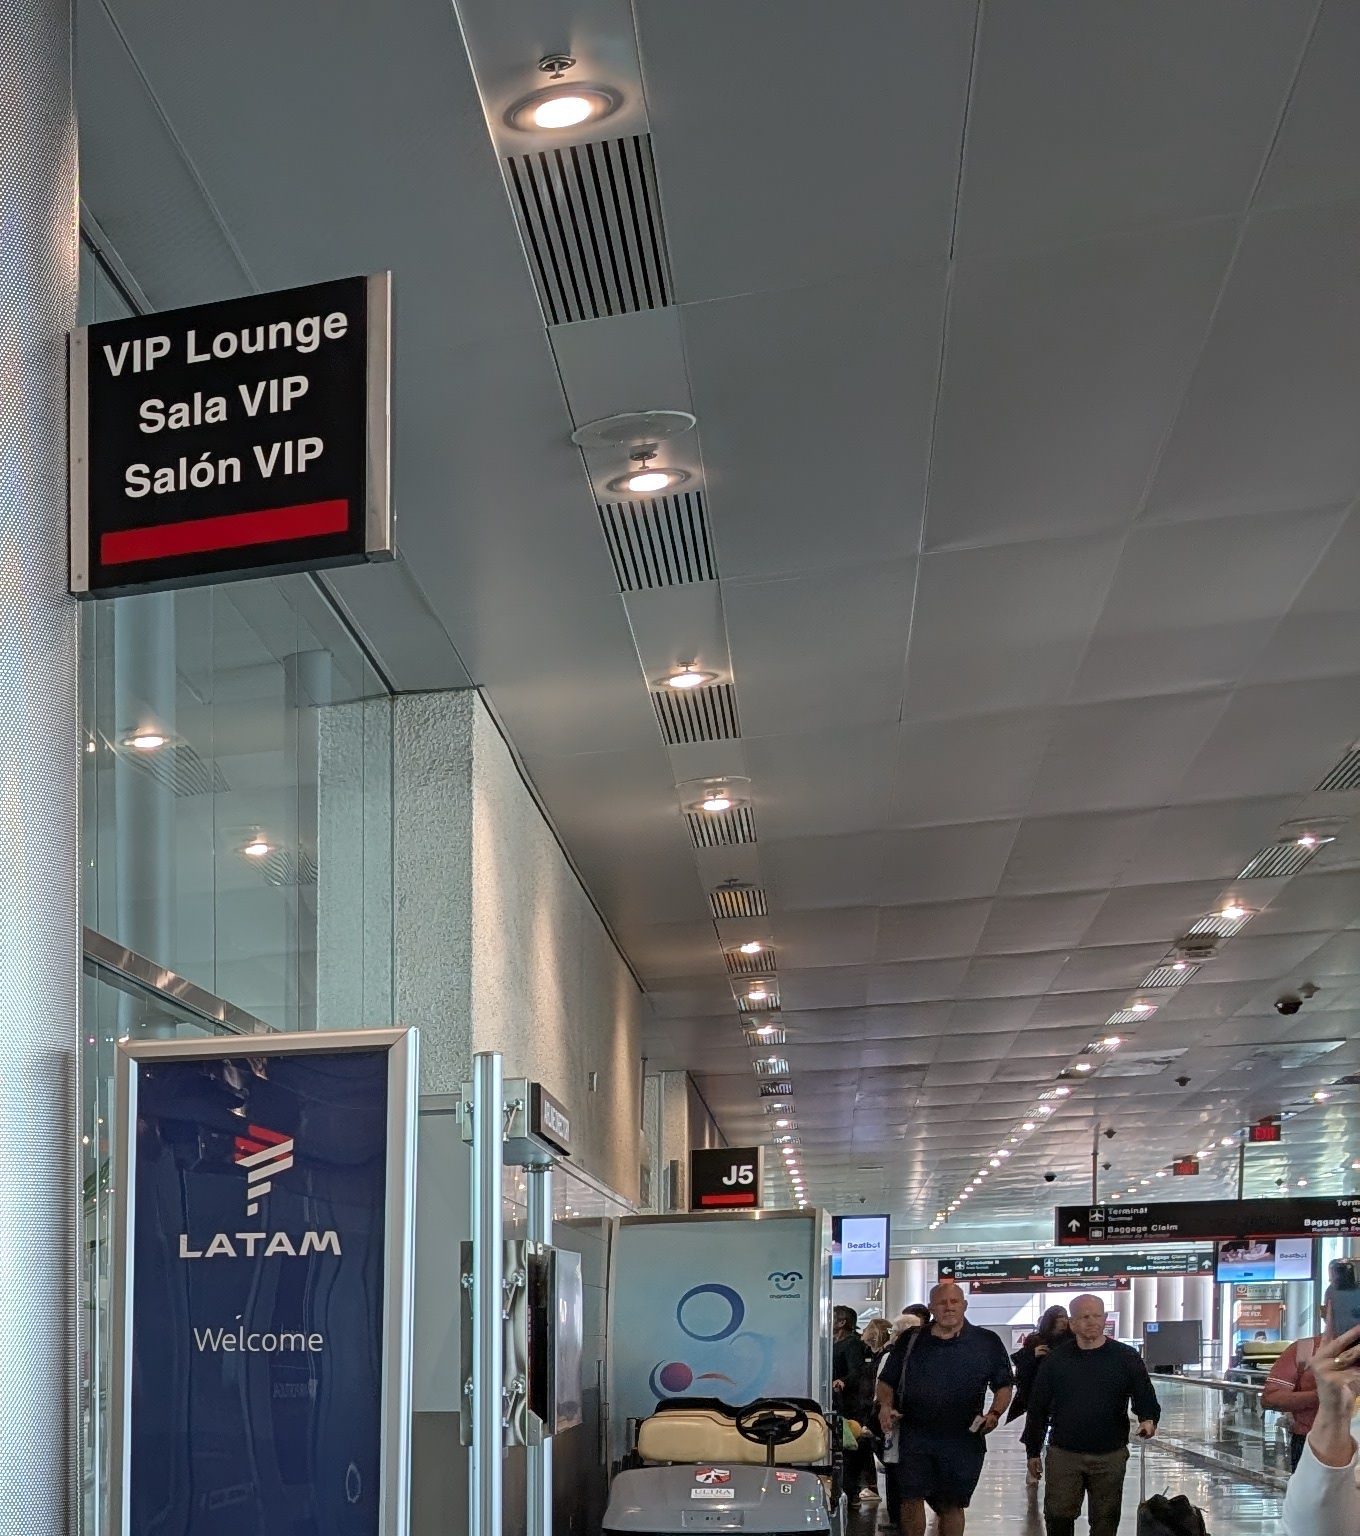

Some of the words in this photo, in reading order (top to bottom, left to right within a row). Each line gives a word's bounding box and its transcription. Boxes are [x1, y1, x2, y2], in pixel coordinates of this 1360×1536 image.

[103, 335, 171, 377] VIP
[186, 310, 349, 364] Lounge
[139, 391, 227, 434] Sala
[238, 375, 309, 417] VIP
[124, 450, 241, 498] Salón
[253, 437, 324, 479] VIP
[722, 1165, 754, 1186] J5
[179, 1231, 342, 1258] LATAM
[193, 1326, 324, 1352] Welcome
[782, 1484, 791, 1494] 6
